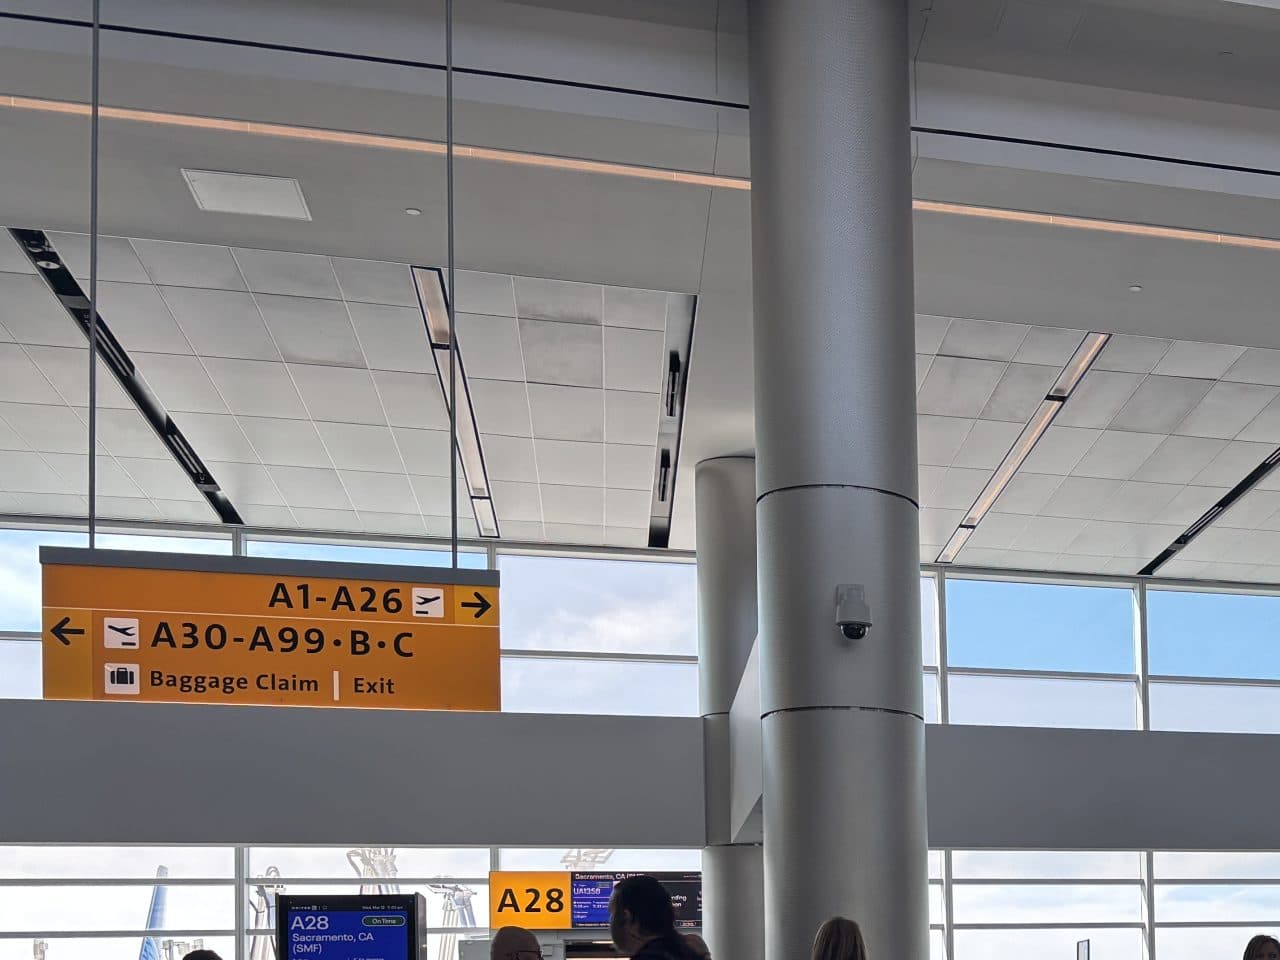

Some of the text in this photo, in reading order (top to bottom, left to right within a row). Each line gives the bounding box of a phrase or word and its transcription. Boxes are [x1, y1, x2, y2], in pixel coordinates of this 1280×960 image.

[267, 581, 403, 614] A1-A26
[150, 670, 395, 696] Baggage Claim Exit
[497, 887, 564, 913] A28
[290, 915, 329, 930] A28
[292, 932, 374, 943] Sacramento, CA
[292, 943, 322, 955] (SMF)
